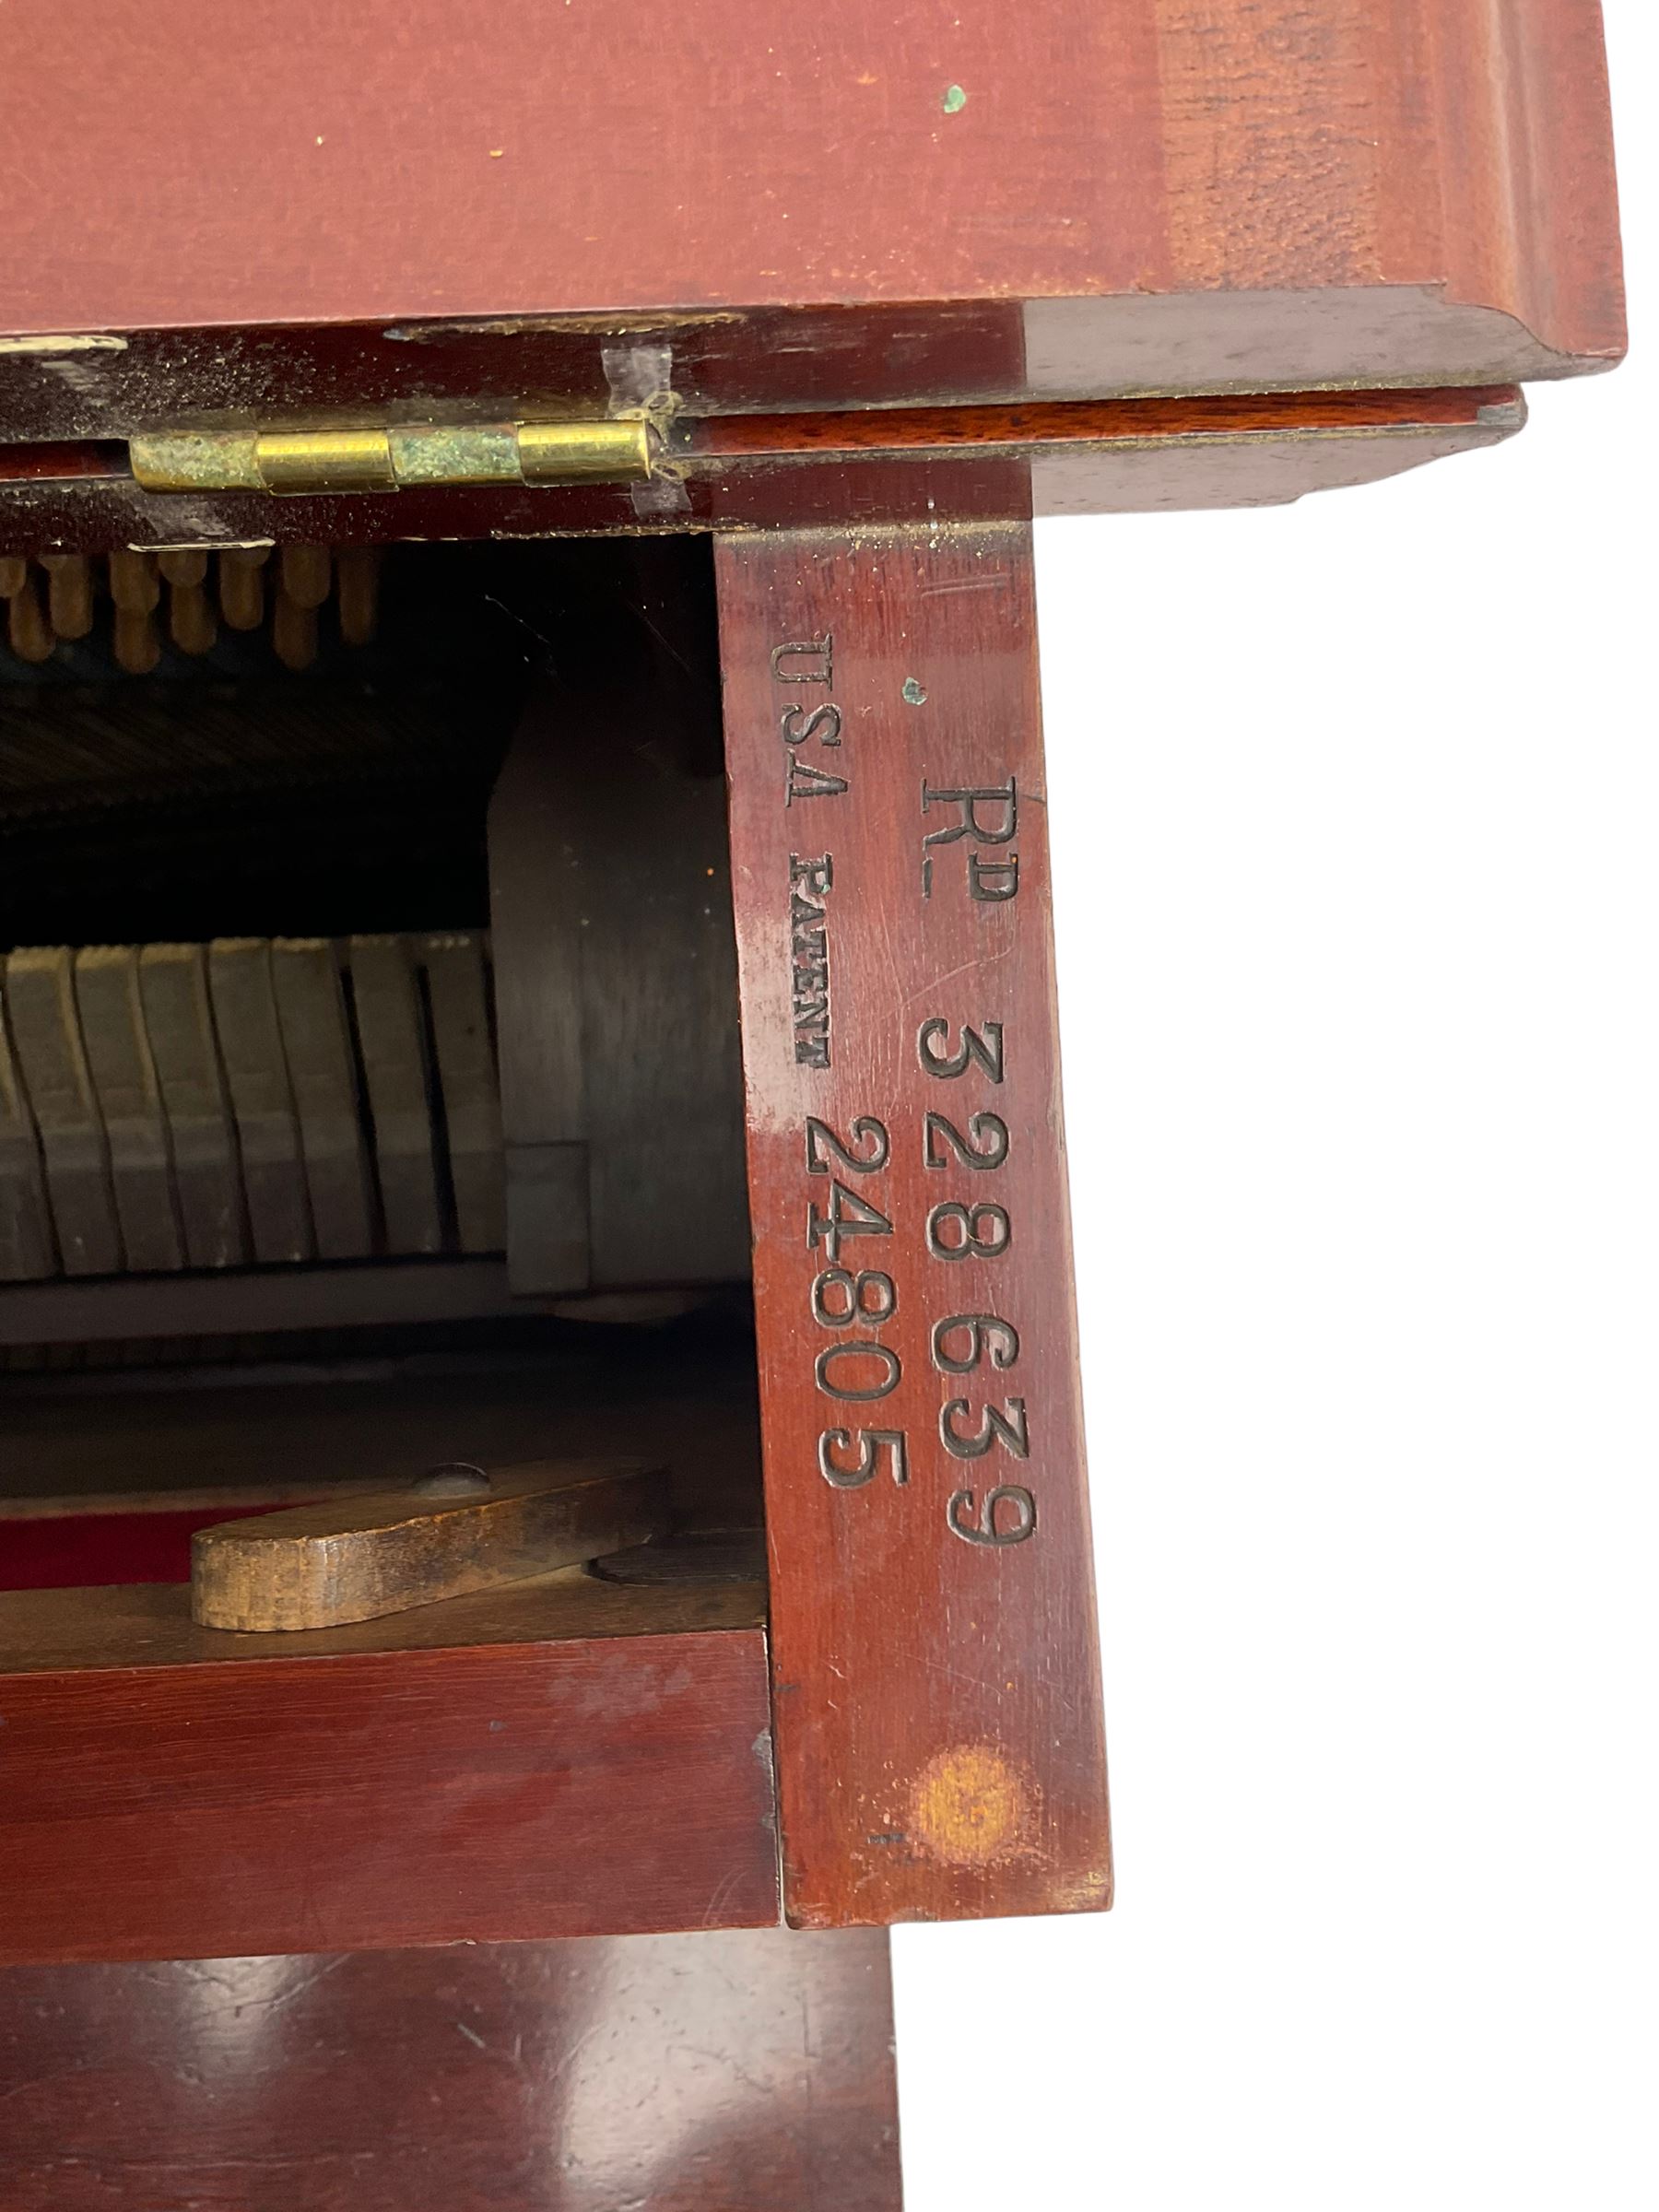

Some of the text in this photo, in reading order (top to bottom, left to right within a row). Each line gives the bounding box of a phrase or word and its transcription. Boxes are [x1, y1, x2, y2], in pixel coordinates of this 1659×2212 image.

[769, 633, 911, 1490] USA PATENT 24805
